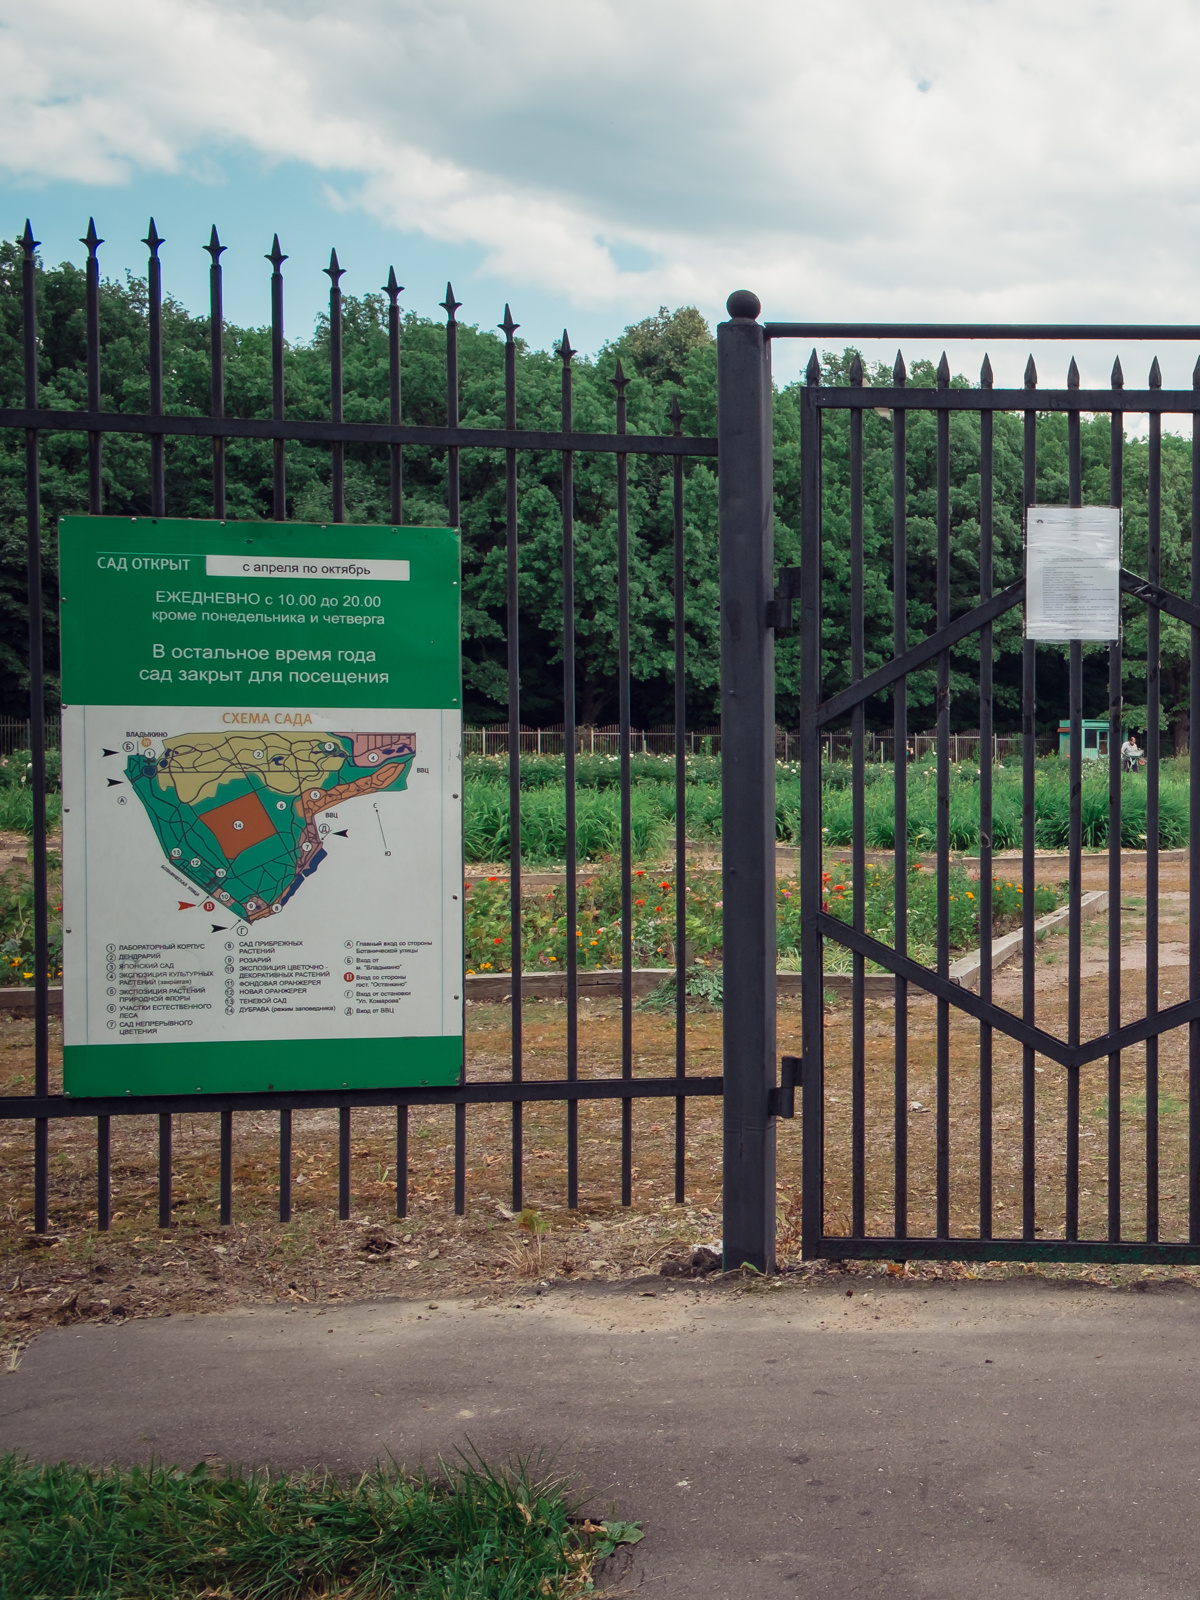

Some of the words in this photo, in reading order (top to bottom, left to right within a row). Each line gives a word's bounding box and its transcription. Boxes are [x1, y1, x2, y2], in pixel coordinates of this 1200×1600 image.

[97, 557, 127, 572] САД
[131, 558, 190, 571] ОТКРЫТ
[243, 564, 250, 572] с
[253, 563, 299, 576] апреля
[303, 565, 317, 574] по
[321, 563, 371, 577] октябрь
[156, 591, 260, 606] ЕЖЕДНЕВНО
[265, 597, 273, 605] с
[278, 594, 316, 606] 10.00
[321, 598, 338, 608] до
[343, 596, 381, 608] 20.00
[152, 611, 197, 624] кроме
[202, 612, 305, 626] понедельника
[310, 615, 318, 623] и
[323, 615, 385, 627] четверга
[153, 644, 165, 659] В
[172, 647, 269, 661] остальное
[275, 649, 332, 664] время
[337, 650, 376, 664] года
[139, 669, 172, 683] сад
[178, 670, 243, 684] закрыт
[248, 671, 282, 684] для
[289, 670, 389, 685] посещения
[222, 712, 271, 725] СХЕМА
[274, 713, 313, 726] САДА
